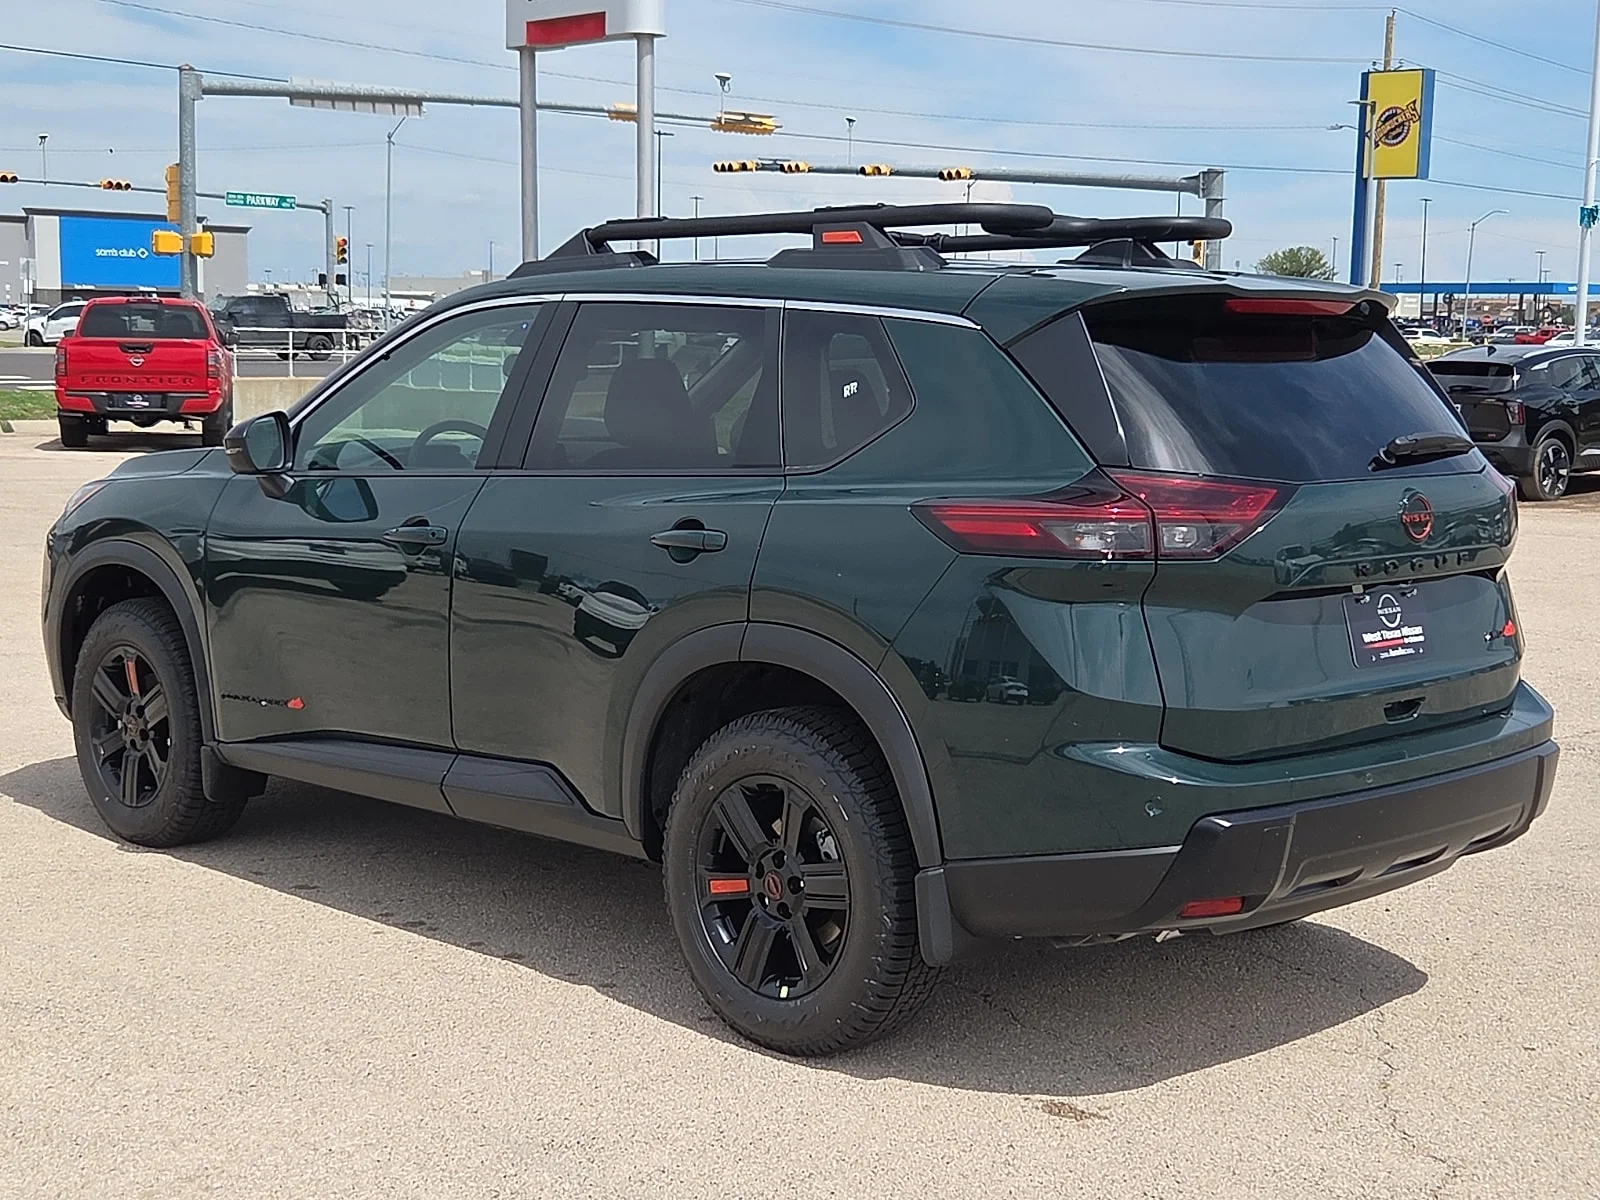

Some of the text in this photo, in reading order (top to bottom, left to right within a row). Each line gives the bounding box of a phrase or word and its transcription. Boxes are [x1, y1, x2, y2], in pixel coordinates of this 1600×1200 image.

[246, 195, 280, 207] PARKWAY
[119, 248, 137, 257] club
[80, 375, 194, 385] FRONTIER
[843, 381, 858, 398] RR
[1356, 551, 1469, 577] ROGUE
[1377, 606, 1401, 615] NISSAN
